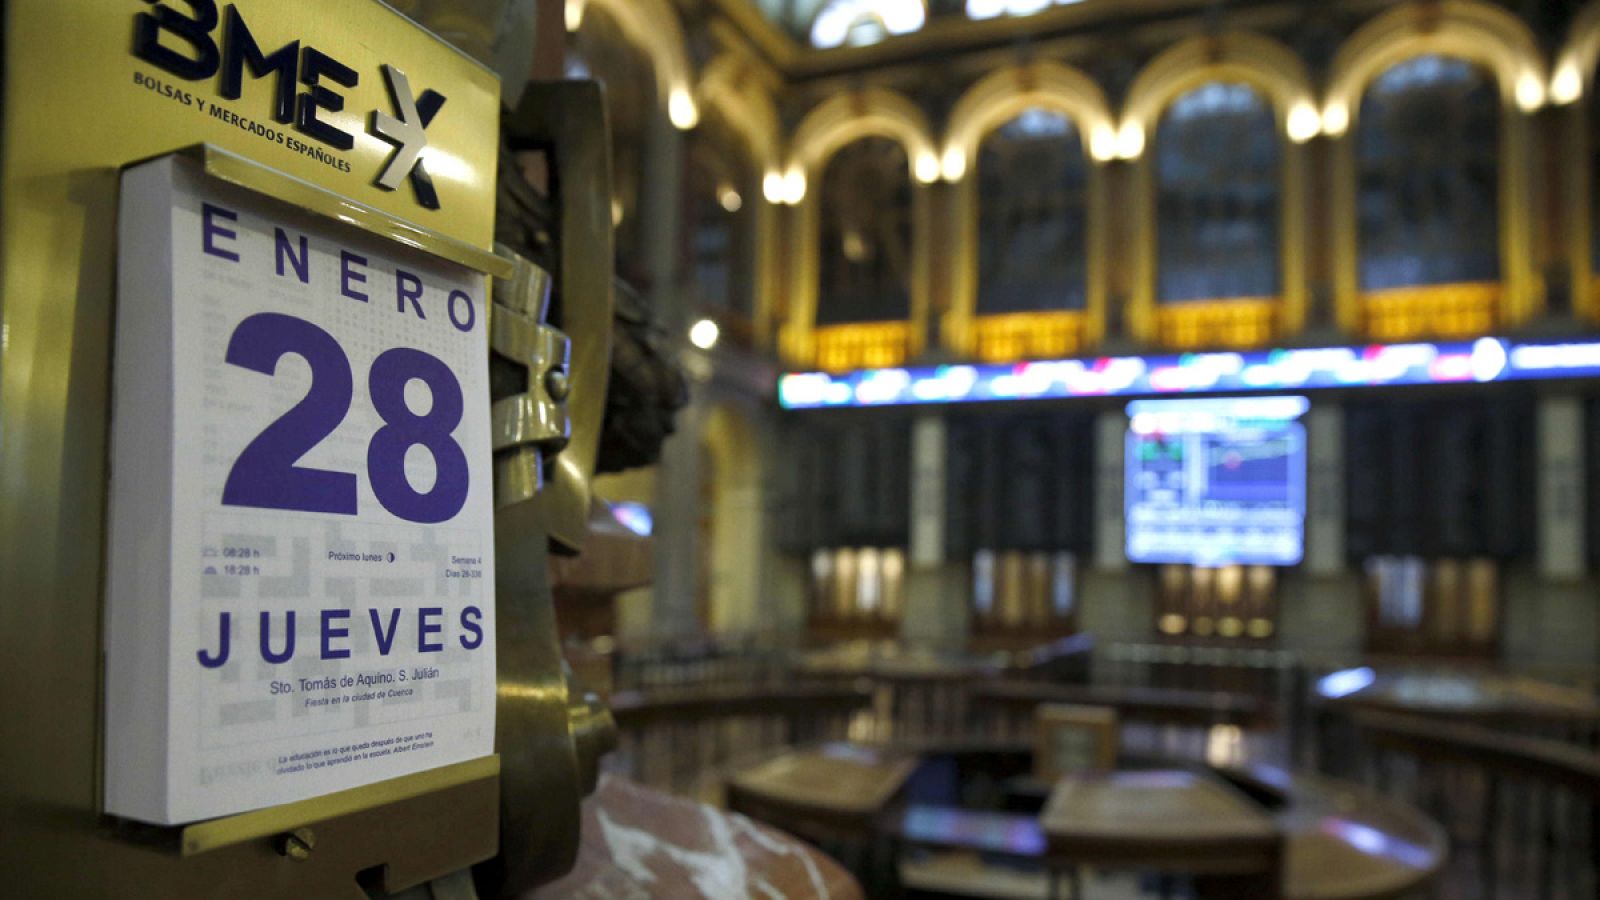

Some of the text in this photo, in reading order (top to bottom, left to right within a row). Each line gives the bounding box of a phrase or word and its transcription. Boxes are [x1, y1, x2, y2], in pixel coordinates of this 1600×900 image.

[132, 71, 351, 173] BOLSAS Y MERCADOS ESPAÑOLES
[202, 202, 476, 333] ENERO
[221, 311, 470, 524] 28
[328, 550, 382, 562] Próximo lunes
[197, 605, 484, 669] JUEVES
[269, 667, 440, 696] Sto. Tomás de Aquino. S. Julián
[331, 695, 341, 705] en
[351, 691, 375, 702] ciudad
[376, 691, 386, 700] de
[387, 688, 414, 699] Cuenca
